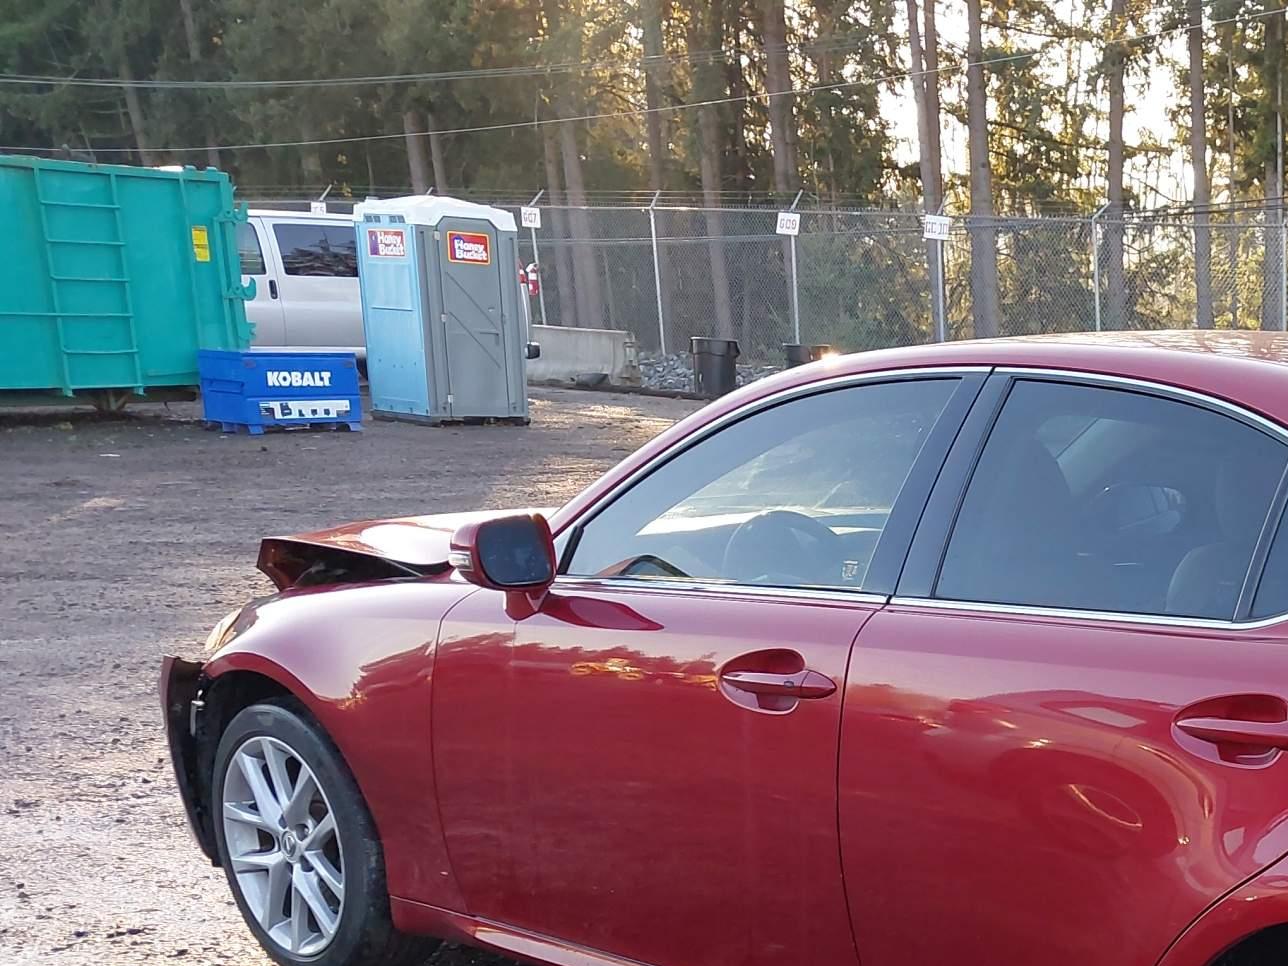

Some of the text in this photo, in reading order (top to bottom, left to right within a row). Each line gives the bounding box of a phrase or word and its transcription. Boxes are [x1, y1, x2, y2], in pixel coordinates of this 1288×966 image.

[377, 231, 401, 245] Honey
[380, 244, 404, 256] Bucket
[455, 239, 485, 254] Honey
[456, 249, 488, 260] Bucket
[266, 371, 332, 386] KOBALT
